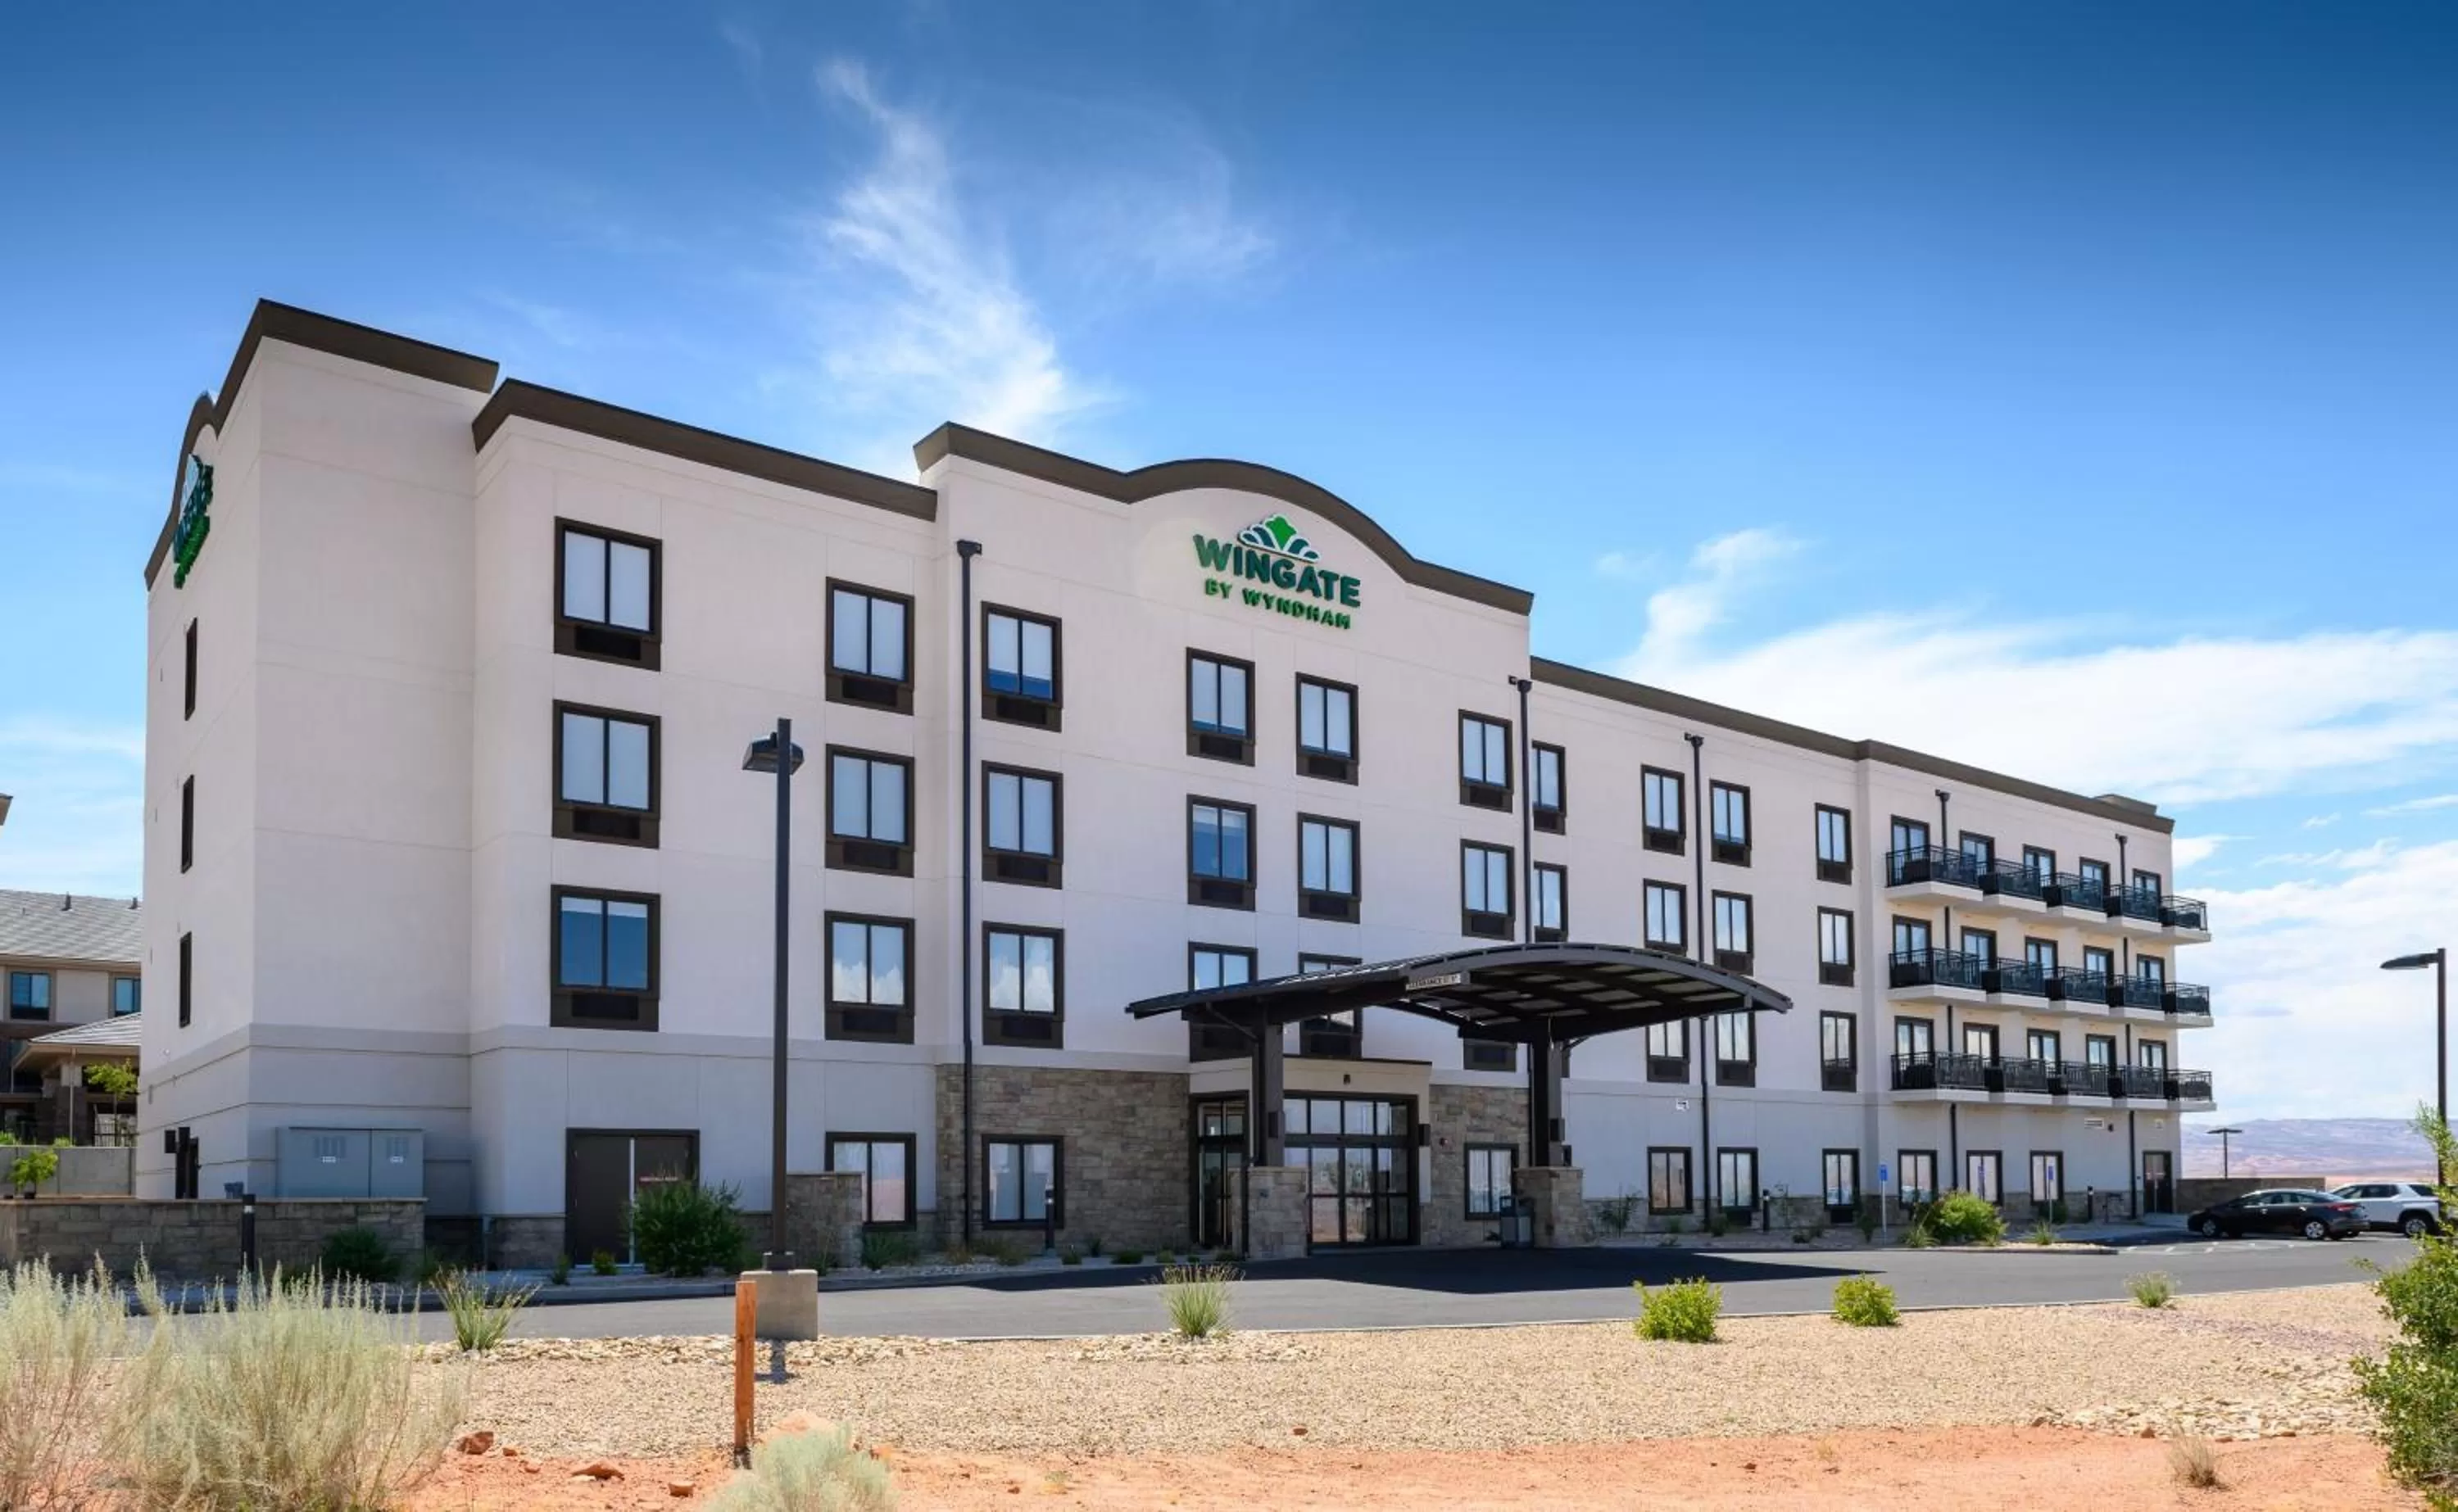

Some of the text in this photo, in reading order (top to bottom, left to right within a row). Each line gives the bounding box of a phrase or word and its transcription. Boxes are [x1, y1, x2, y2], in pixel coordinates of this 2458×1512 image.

[1193, 534, 1361, 608] WINGATE
[1204, 577, 1351, 630] BY WYNDHAM
